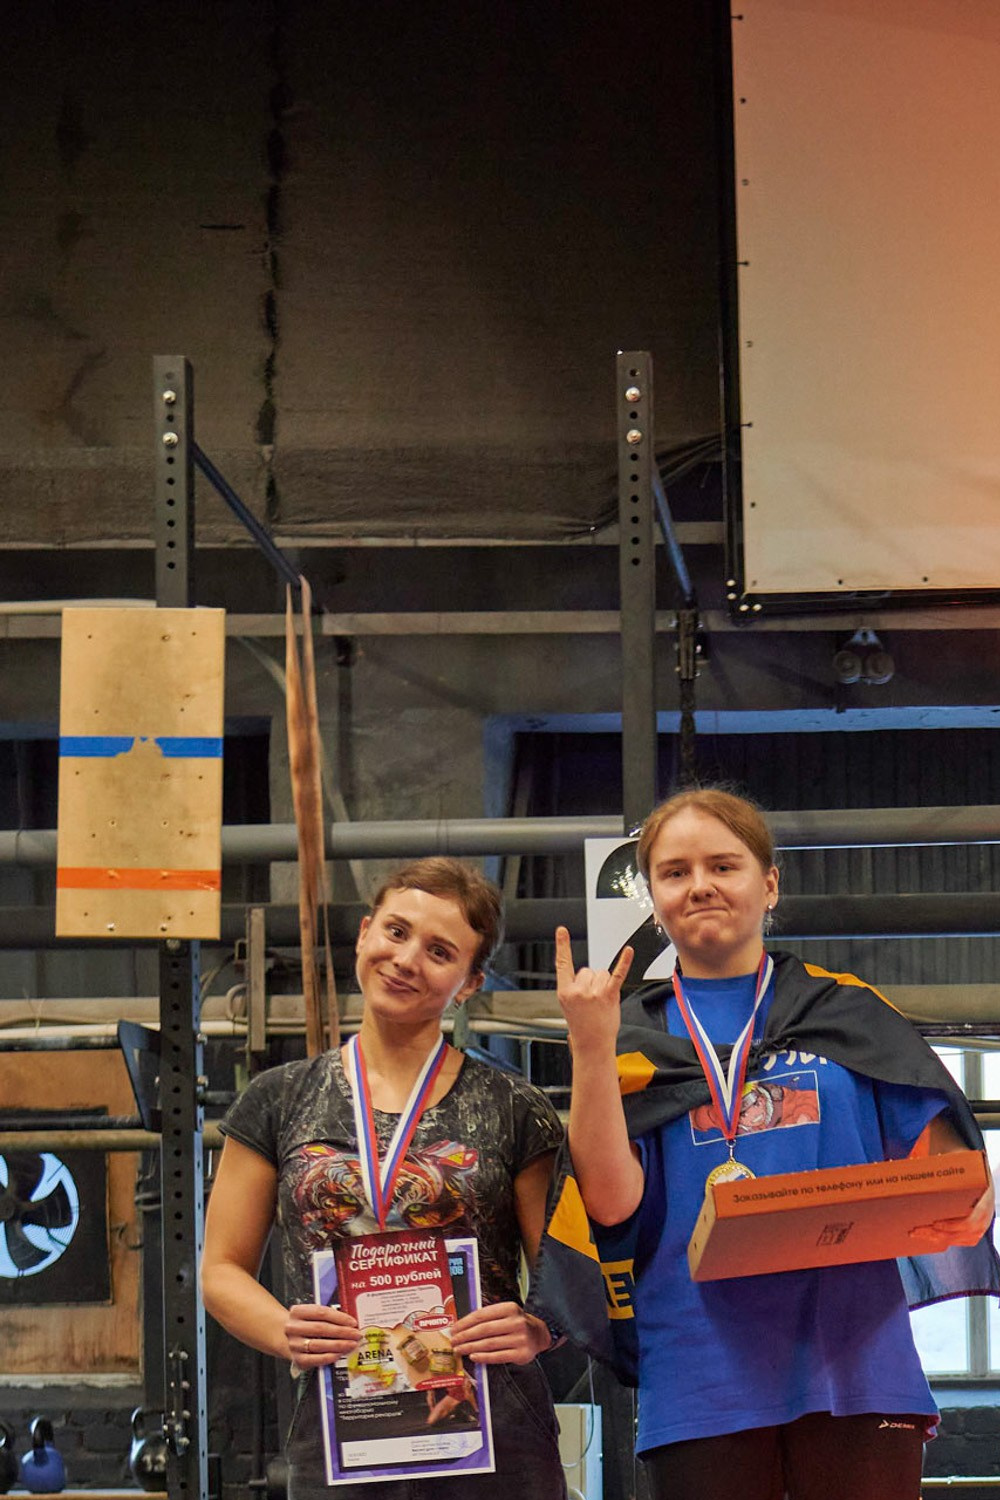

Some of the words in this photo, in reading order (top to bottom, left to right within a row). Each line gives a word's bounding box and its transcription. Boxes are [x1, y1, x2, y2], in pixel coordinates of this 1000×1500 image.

[733, 1186, 799, 1203] Заказывайте
[801, 1185, 814, 1195] по
[816, 1179, 863, 1194] телефону
[866, 1178, 883, 1187] или
[885, 1175, 899, 1184] на
[901, 1171, 934, 1182] нашем
[936, 1166, 965, 1177] сайте
[350, 1236, 437, 1262] Подарочный
[349, 1250, 438, 1271] СЕРТИФИКАТ
[351, 1281, 366, 1290] на
[369, 1273, 392, 1287] 500
[395, 1268, 442, 1286] рублей
[357, 1348, 394, 1361] ARENA
